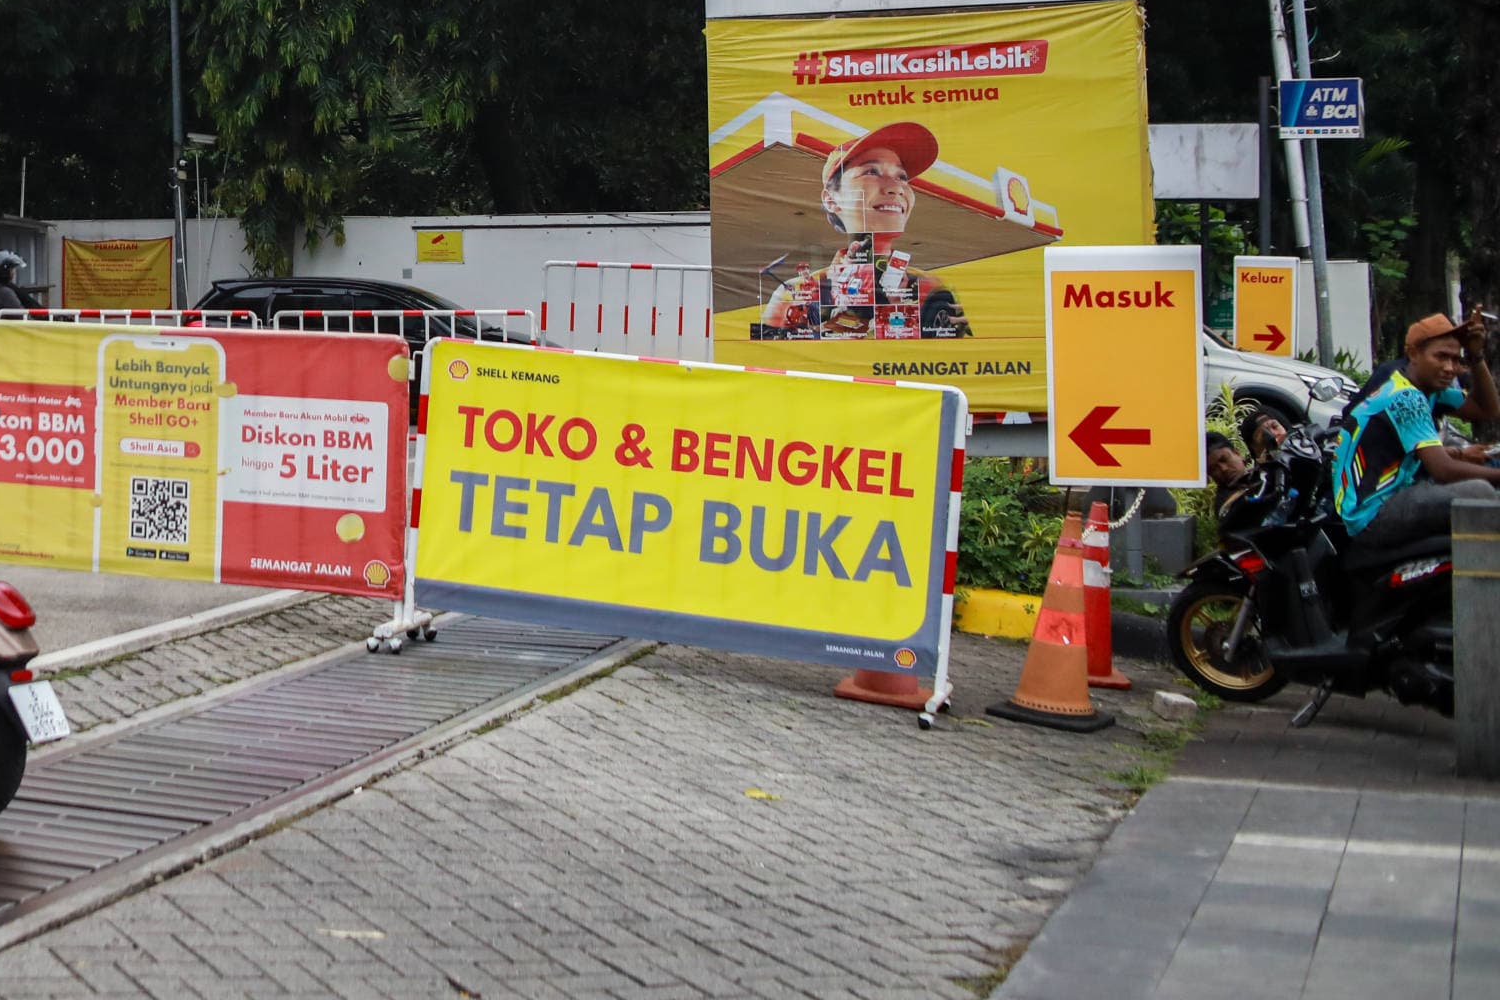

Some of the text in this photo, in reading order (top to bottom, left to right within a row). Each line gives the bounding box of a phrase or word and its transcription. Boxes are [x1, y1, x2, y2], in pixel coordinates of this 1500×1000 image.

[792, 46, 1032, 85] #ShellKasihLebih
[849, 85, 999, 107] untuk semua
[1309, 87, 1348, 102] ATM
[1322, 104, 1357, 119] BCA
[1241, 271, 1285, 285] Keluar
[1063, 280, 1175, 308] Masuk
[115, 359, 210, 378] Lebih Banyak
[476, 367, 560, 384] SHELL KEMANG
[872, 361, 1031, 376] SEMANGAT JALAN
[109, 376, 213, 396] Untungnya jadi
[114, 393, 211, 411] Member Baru
[38, 412, 86, 435] BBM
[129, 412, 199, 428] Shell GO+
[243, 408, 348, 423] Member Baru Akun Mobil
[241, 424, 373, 451] Diskon BBM
[130, 441, 179, 454] Shell Asia
[458, 405, 916, 499] TOKO & BENGKEL
[241, 455, 274, 471] hingga
[279, 453, 297, 479] 5
[306, 454, 374, 484] Liter
[449, 469, 913, 589] TETAP BUKA
[250, 557, 351, 577] SEMANGAT JALAN
[825, 644, 885, 659] SEMANGAT JALAN
